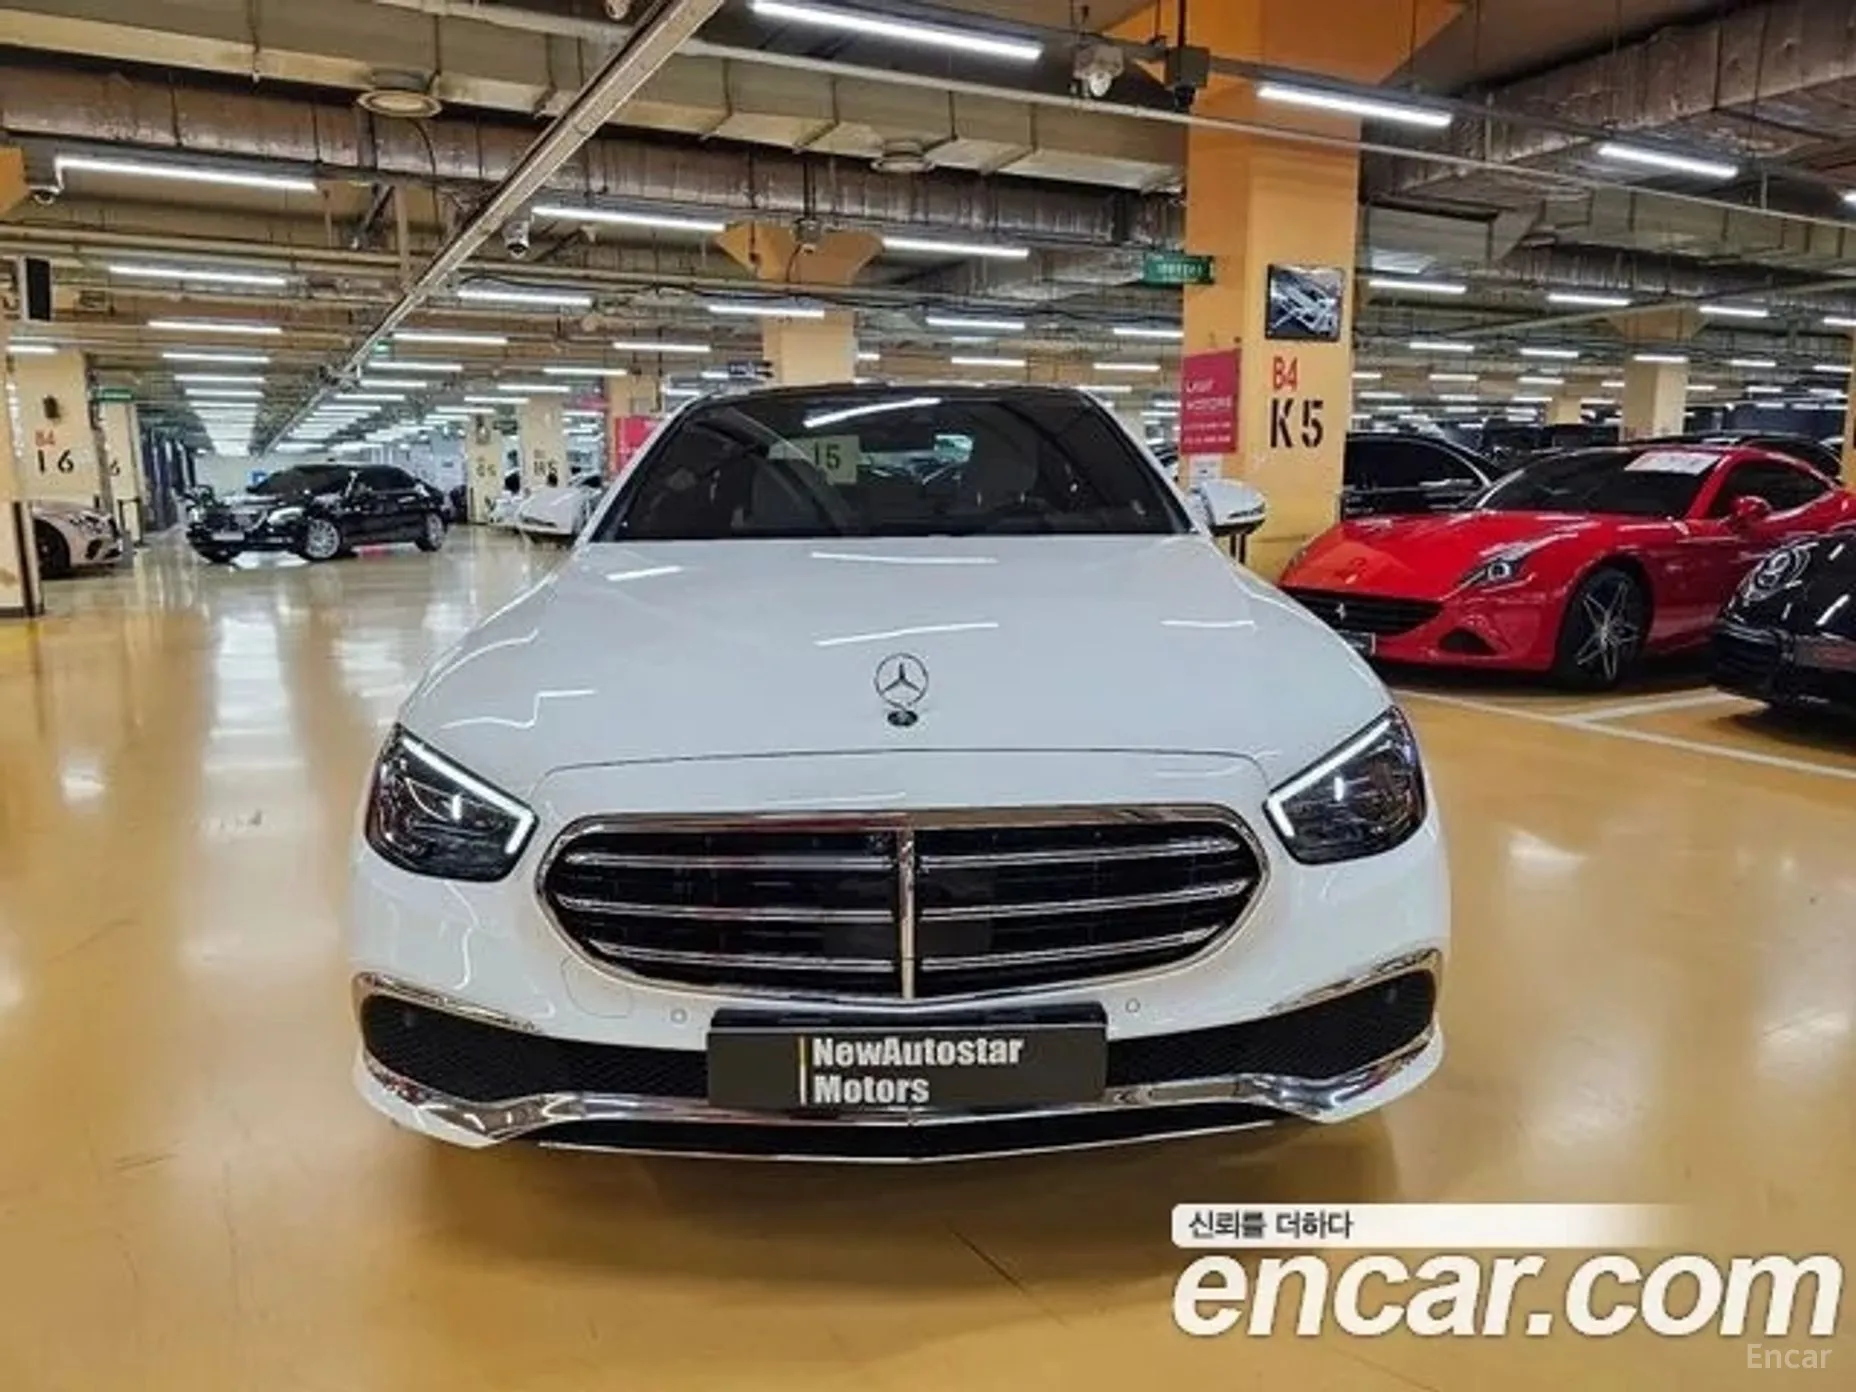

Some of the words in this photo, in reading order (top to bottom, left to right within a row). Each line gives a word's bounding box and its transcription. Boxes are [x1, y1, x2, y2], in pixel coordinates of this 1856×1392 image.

[1273, 356, 1299, 392] B4
[811, 1036, 1024, 1068] NewAutostar
[812, 1075, 930, 1104] Motors
